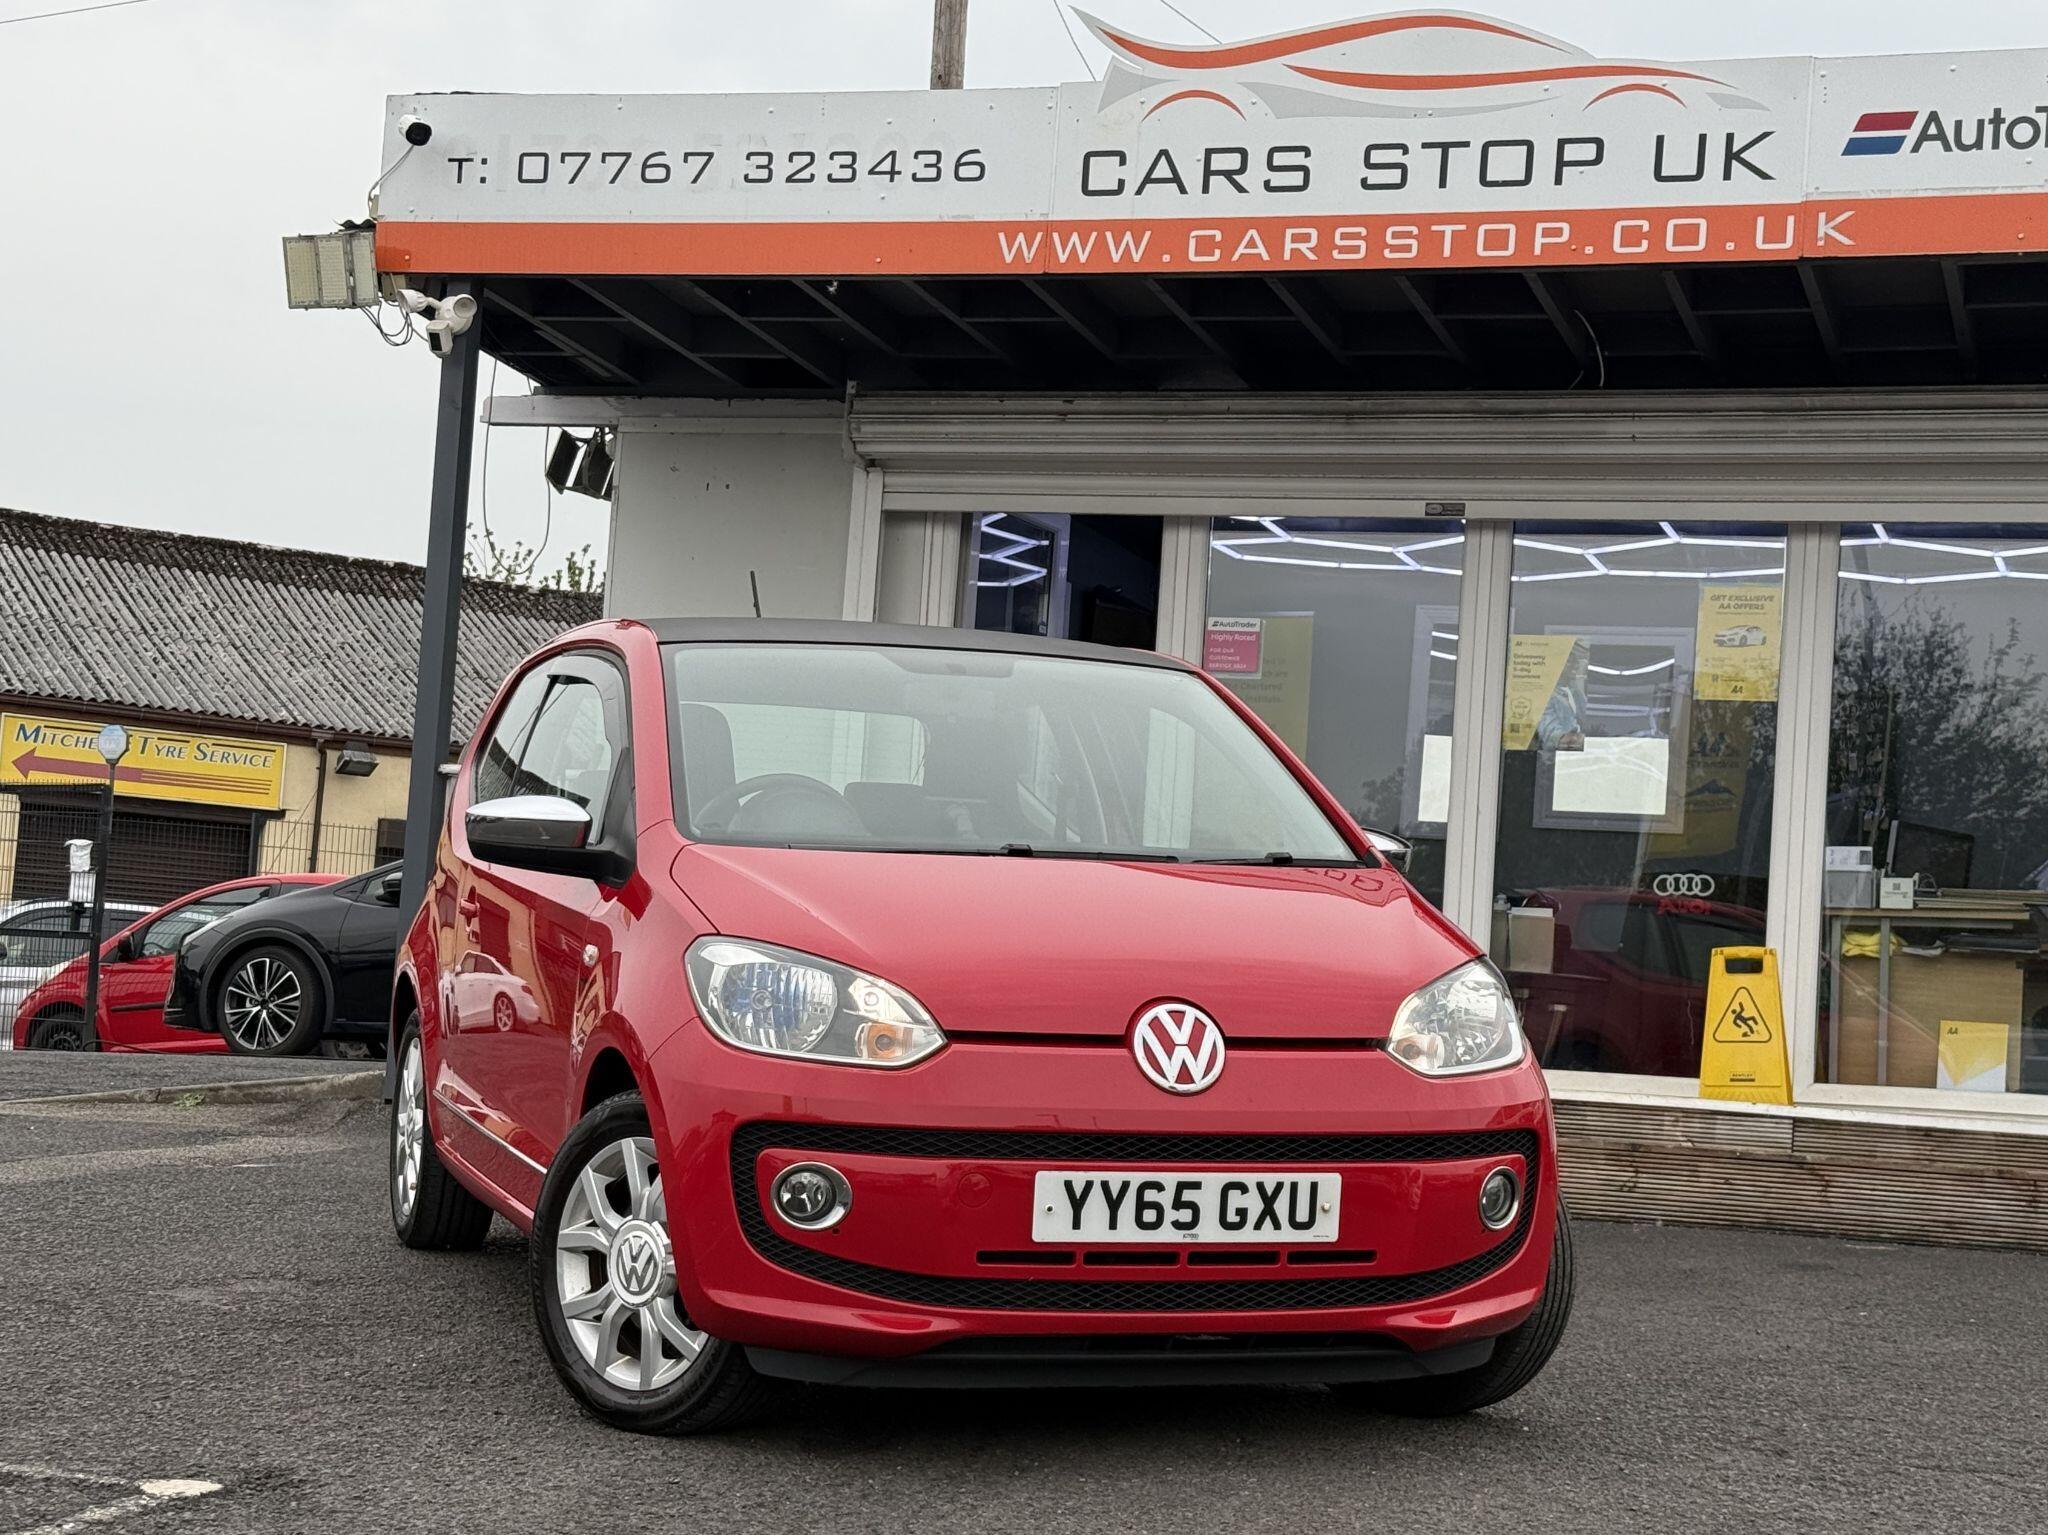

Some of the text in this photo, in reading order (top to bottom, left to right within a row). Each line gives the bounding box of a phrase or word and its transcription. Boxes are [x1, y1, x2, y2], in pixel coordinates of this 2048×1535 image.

[447, 148, 986, 185] T: 07767 323436
[1081, 130, 1776, 197] CARS STOP UK
[998, 209, 1856, 264] WWW.CARSSTOP.CO.UK
[1728, 594, 1775, 603] EXCLUSIVE
[1733, 603, 1765, 611] OFFERS
[1211, 633, 1233, 641] Highly
[194, 743, 273, 769] SERVICE
[1063, 1179, 1319, 1232] YY65 GXU
